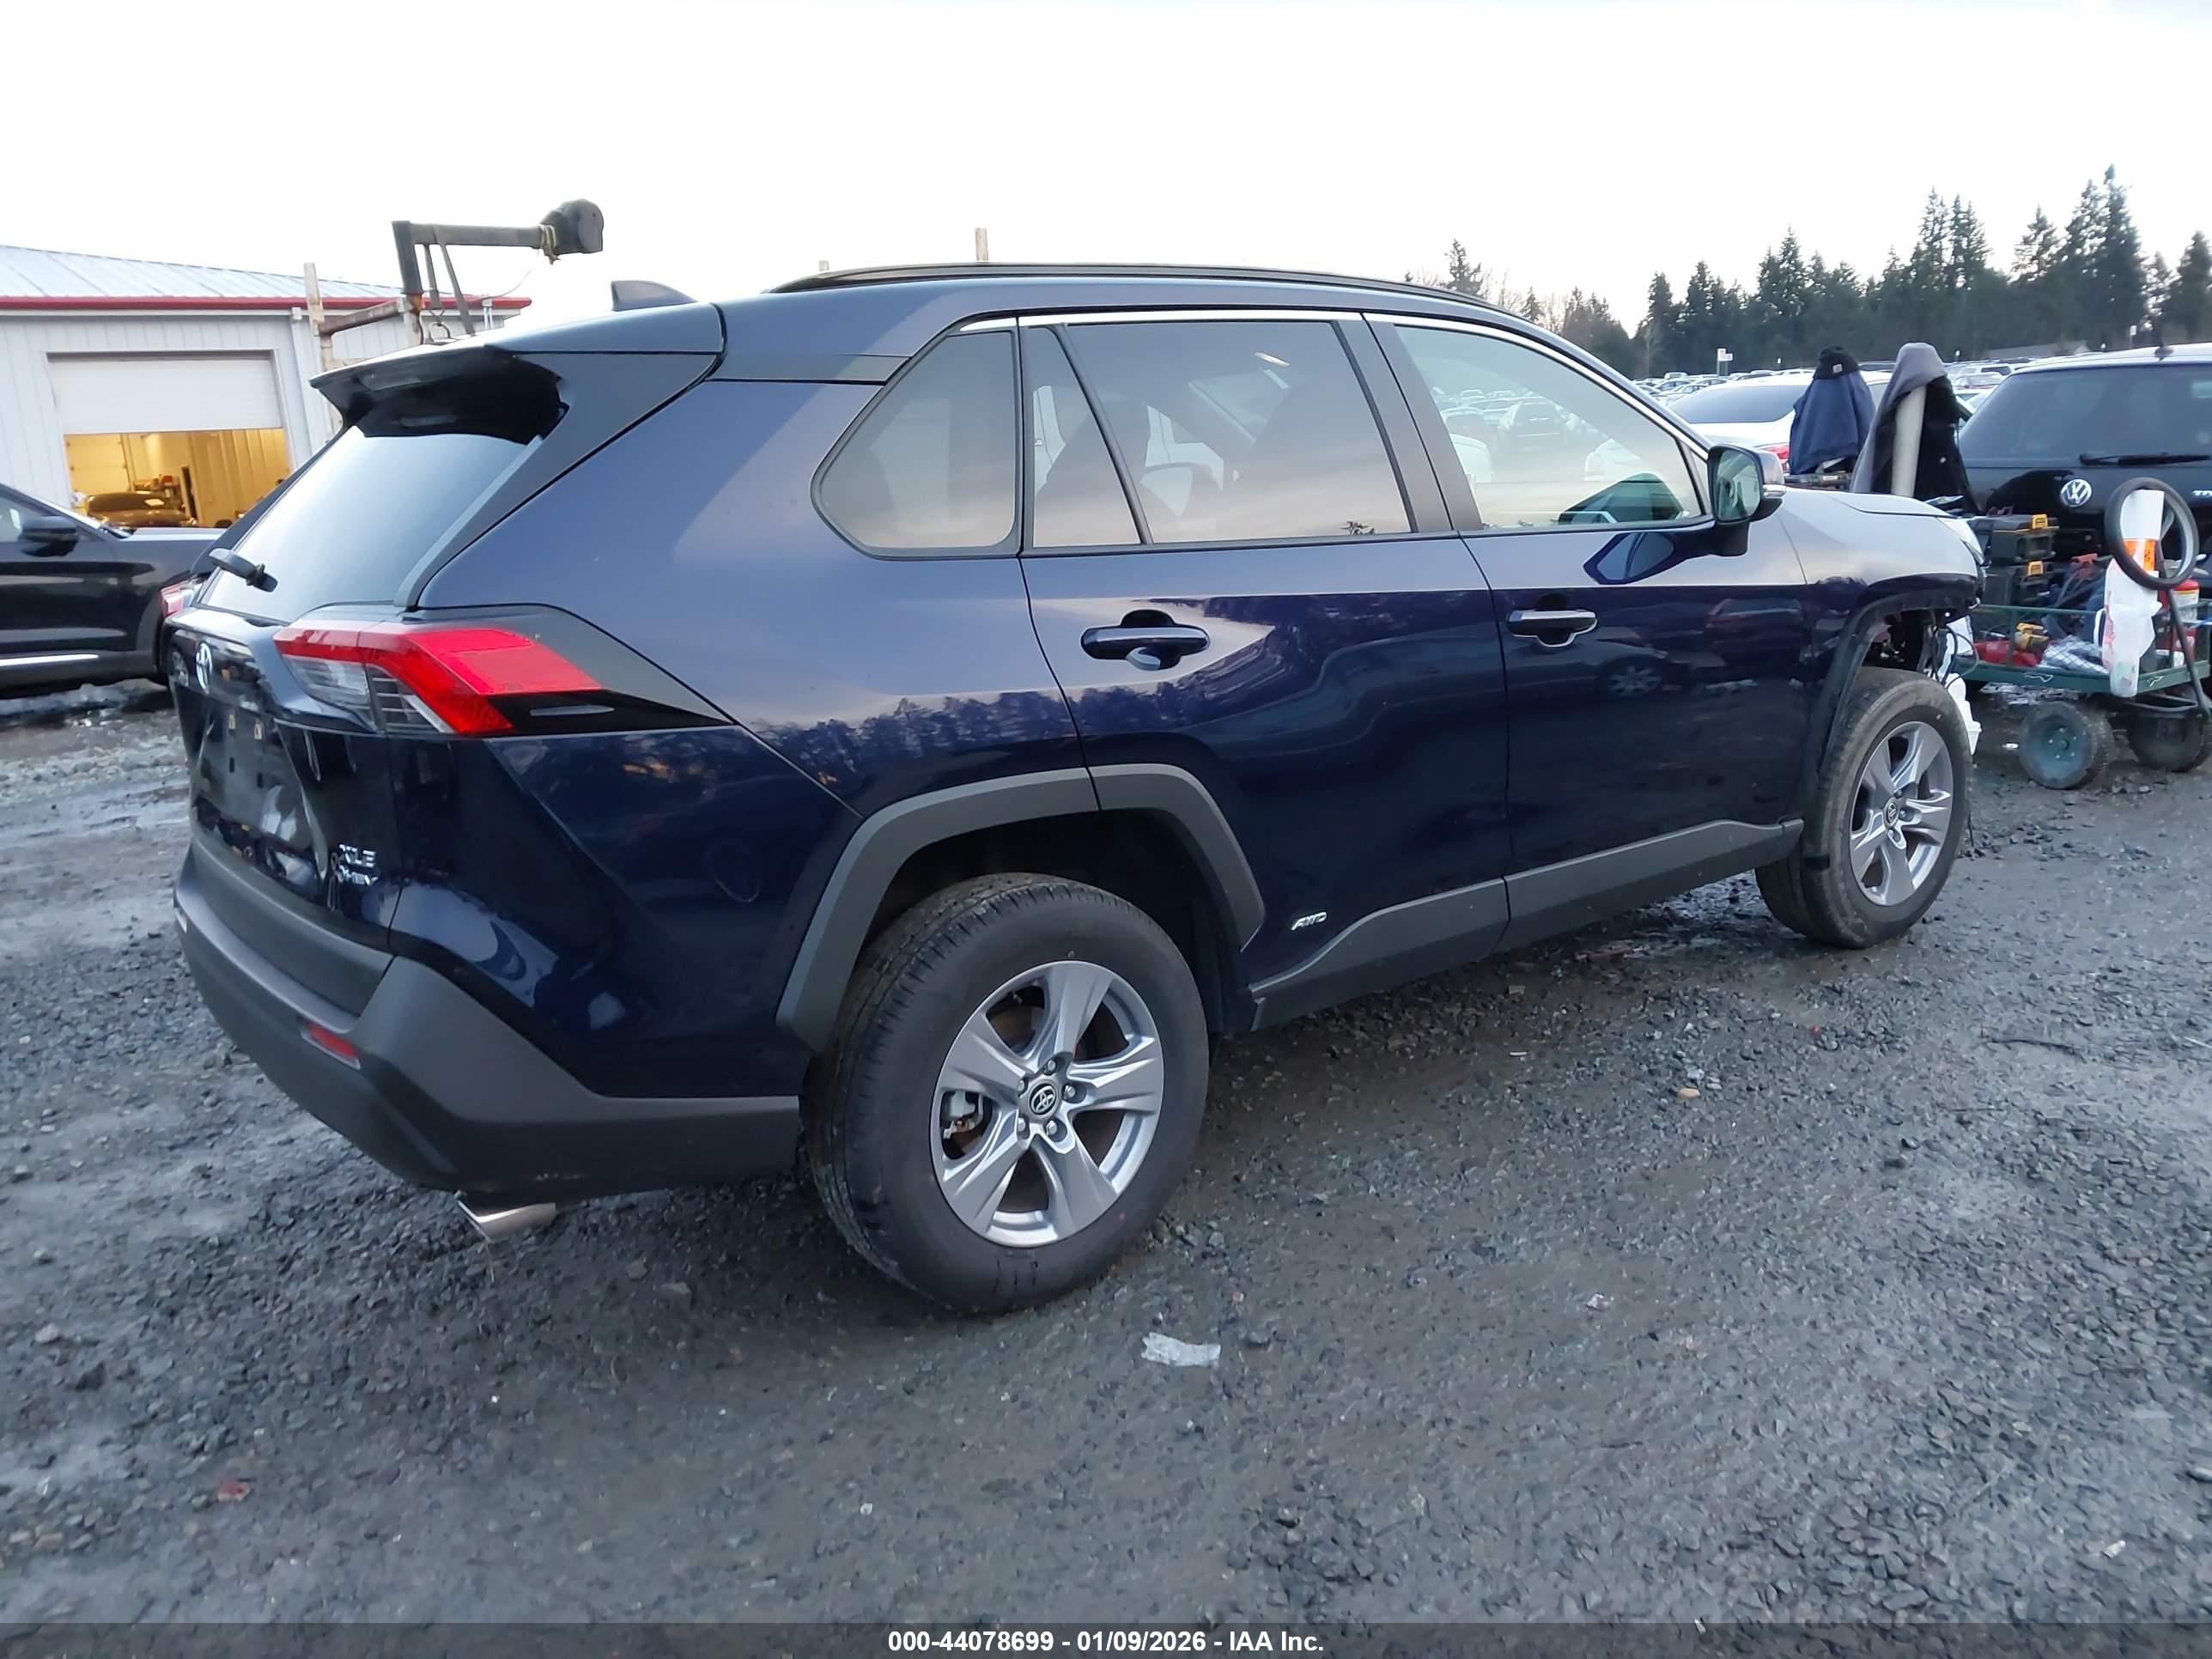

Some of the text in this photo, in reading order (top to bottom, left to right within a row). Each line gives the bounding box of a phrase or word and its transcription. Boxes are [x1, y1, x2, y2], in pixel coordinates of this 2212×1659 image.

[2060, 478, 2093, 508] VW
[337, 843, 377, 868] XLE
[1291, 910, 1328, 931] AWD
